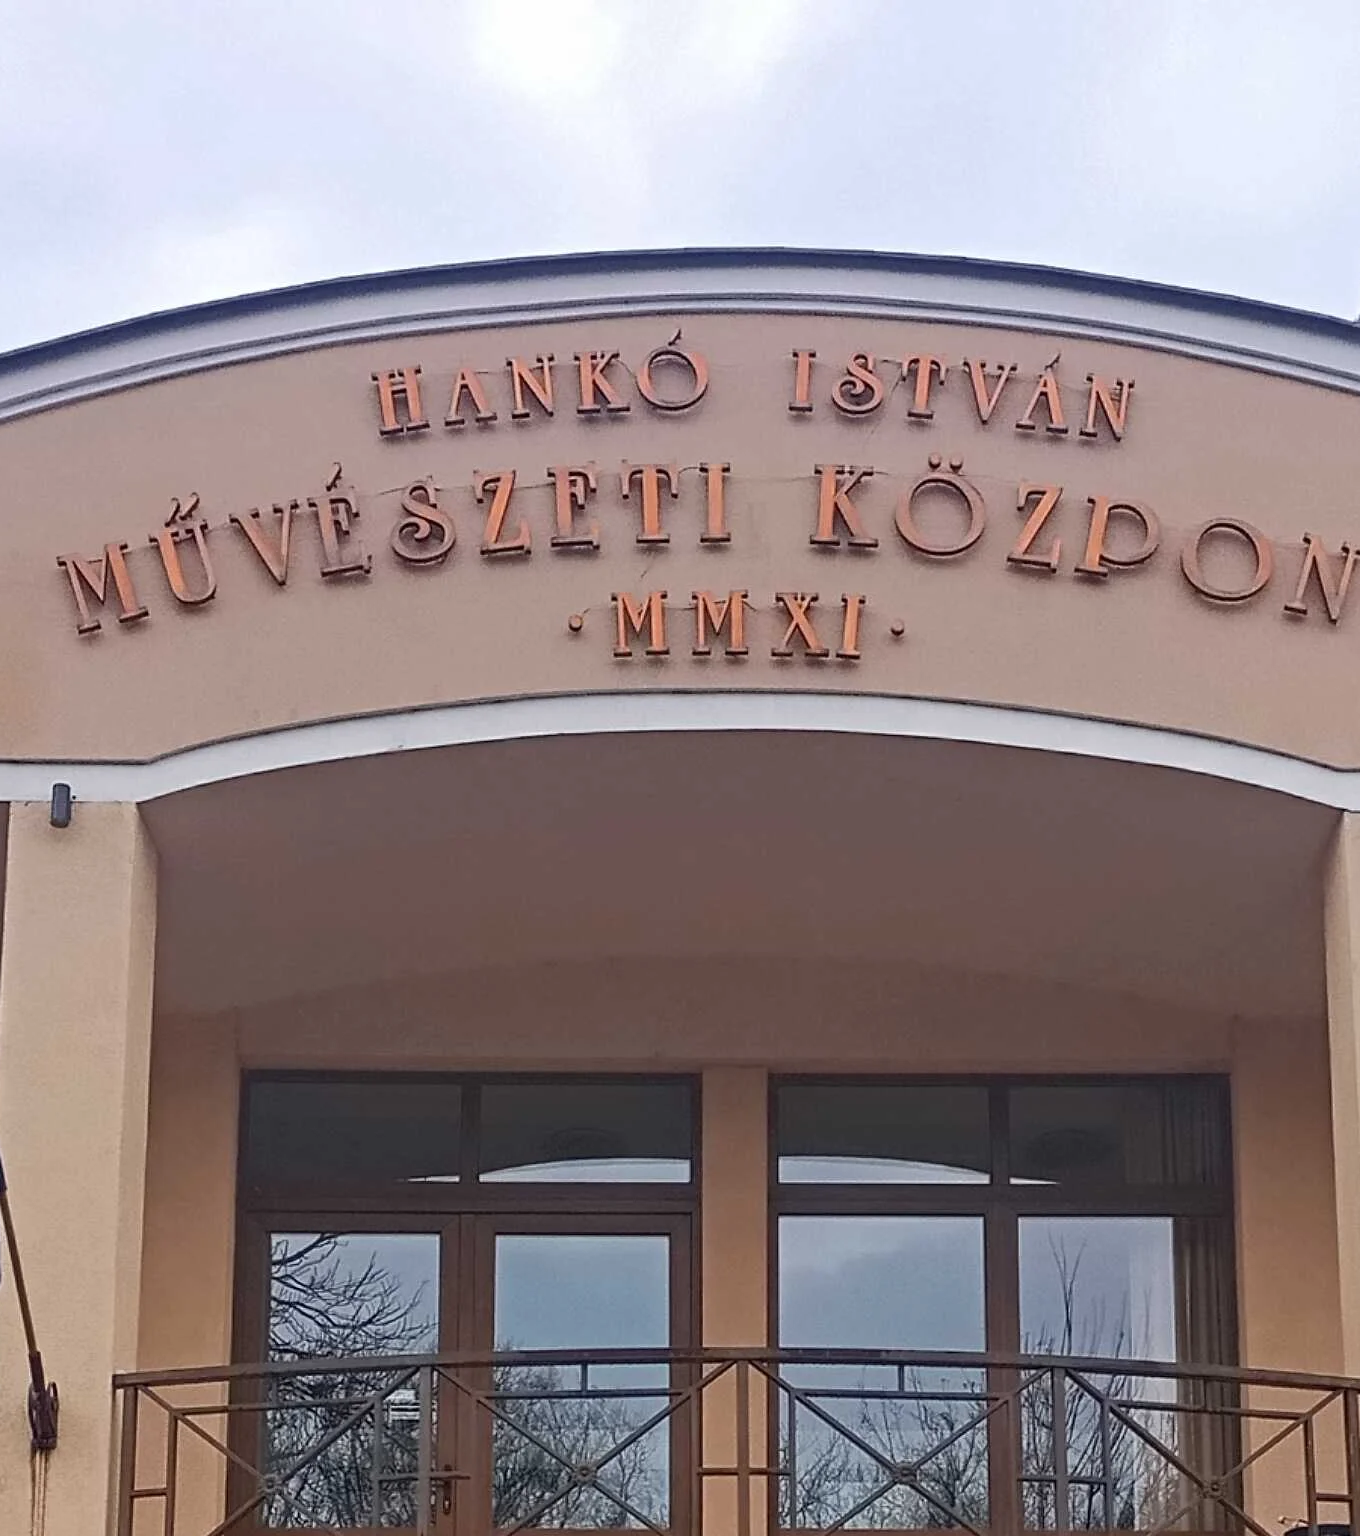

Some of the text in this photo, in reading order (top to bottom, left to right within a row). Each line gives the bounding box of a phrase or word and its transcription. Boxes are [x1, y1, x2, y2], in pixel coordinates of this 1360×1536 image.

[371, 329, 1136, 442] HANKÓ ISTVÁN
[56, 461, 732, 635] MŰVÉSZETI
